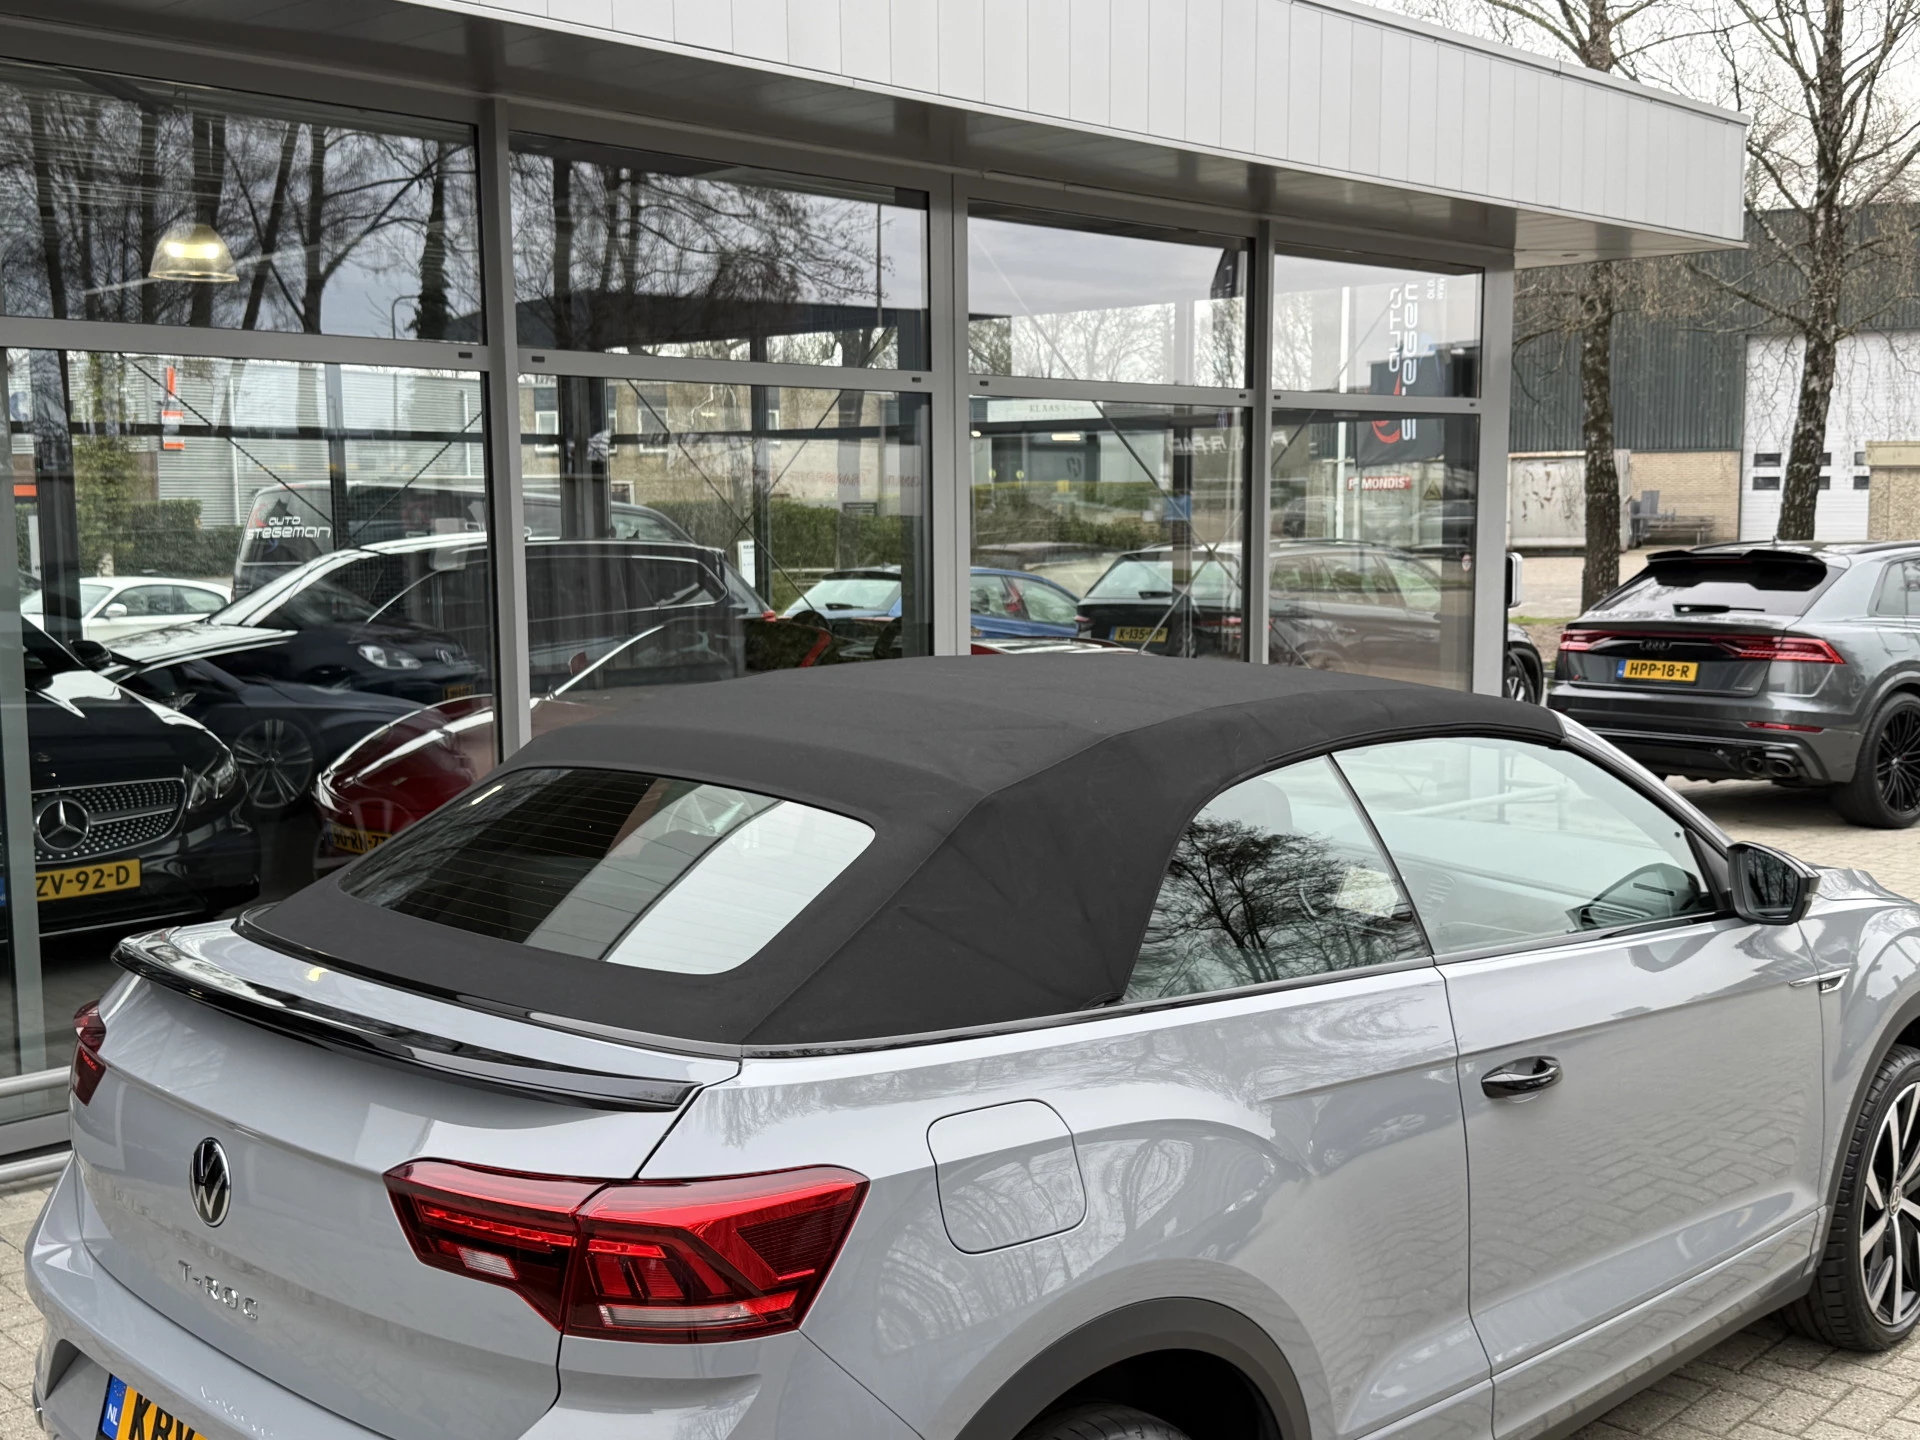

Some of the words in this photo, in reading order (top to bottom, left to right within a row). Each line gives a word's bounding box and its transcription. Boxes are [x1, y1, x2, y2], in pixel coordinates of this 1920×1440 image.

[1629, 662, 1690, 678] HPP-18-R
[36, 865, 130, 897] ZV-92-D
[178, 1259, 258, 1320] T-ROC
